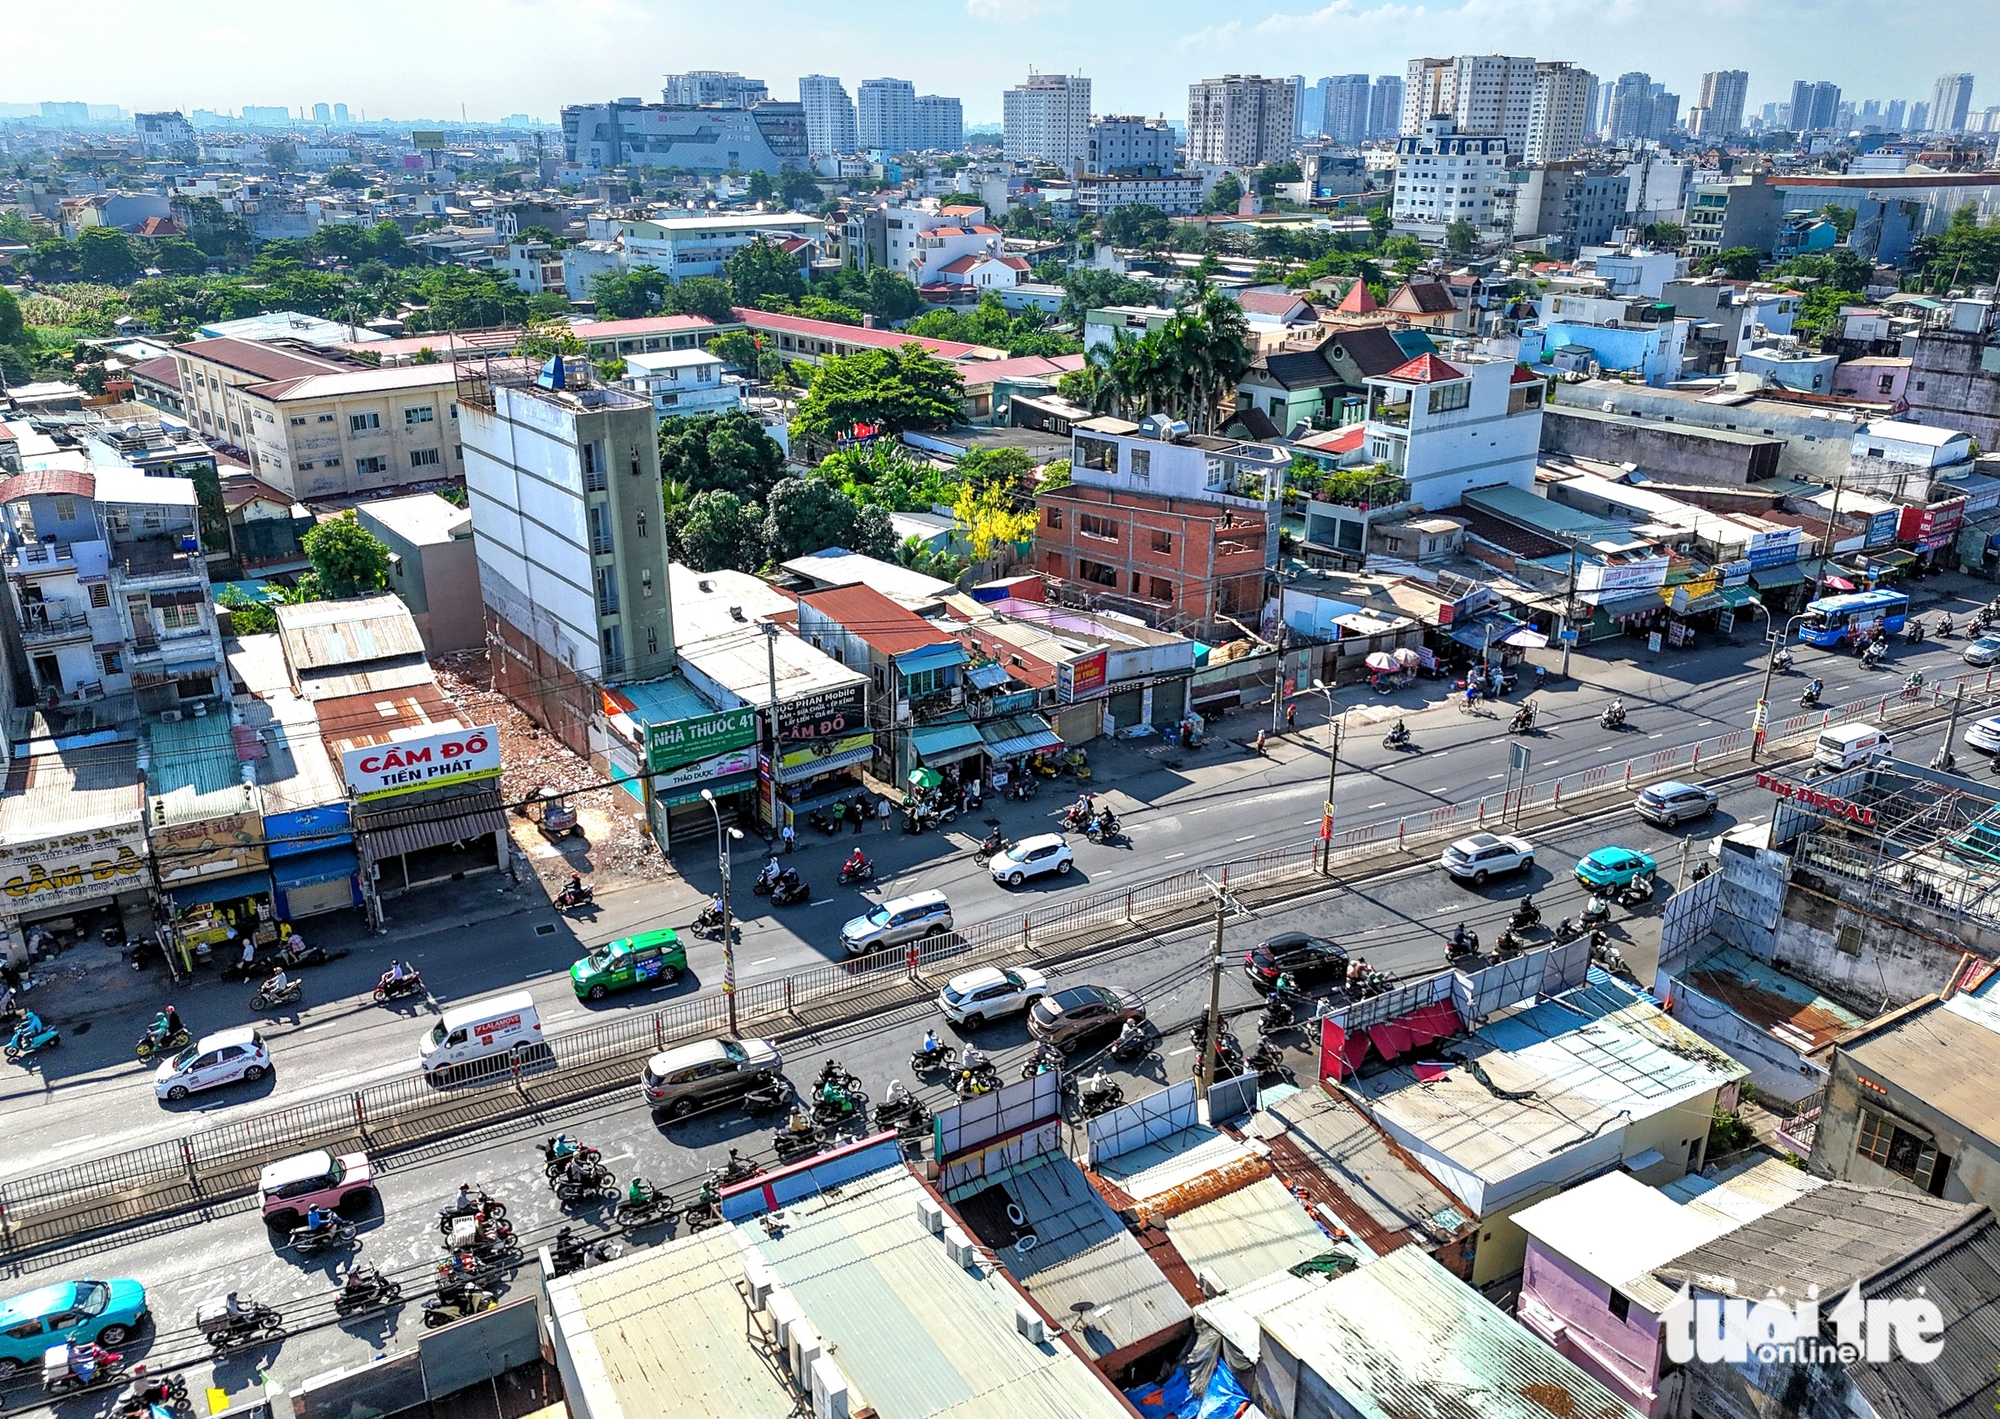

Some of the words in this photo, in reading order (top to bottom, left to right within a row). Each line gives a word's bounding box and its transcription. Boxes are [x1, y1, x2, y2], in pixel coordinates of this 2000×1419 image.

[825, 688, 855, 701] Mobile
[654, 726, 685, 746] NHÀ
[688, 714, 736, 739] THUỐC
[739, 713, 754, 728] 41
[359, 746, 432, 774] CẦM
[440, 731, 489, 759] ĐỒ
[380, 768, 422, 786] TIẾN
[428, 759, 473, 778] PHÁT
[673, 774, 693, 784] THẢO
[694, 769, 714, 780] DƯỢC
[1756, 772, 1792, 798] Thi
[1796, 786, 1877, 826] DECAL
[4, 863, 83, 897] CẦM
[91, 846, 143, 880] ĐỒ
[481, 1016, 520, 1031] LALAMOVE
